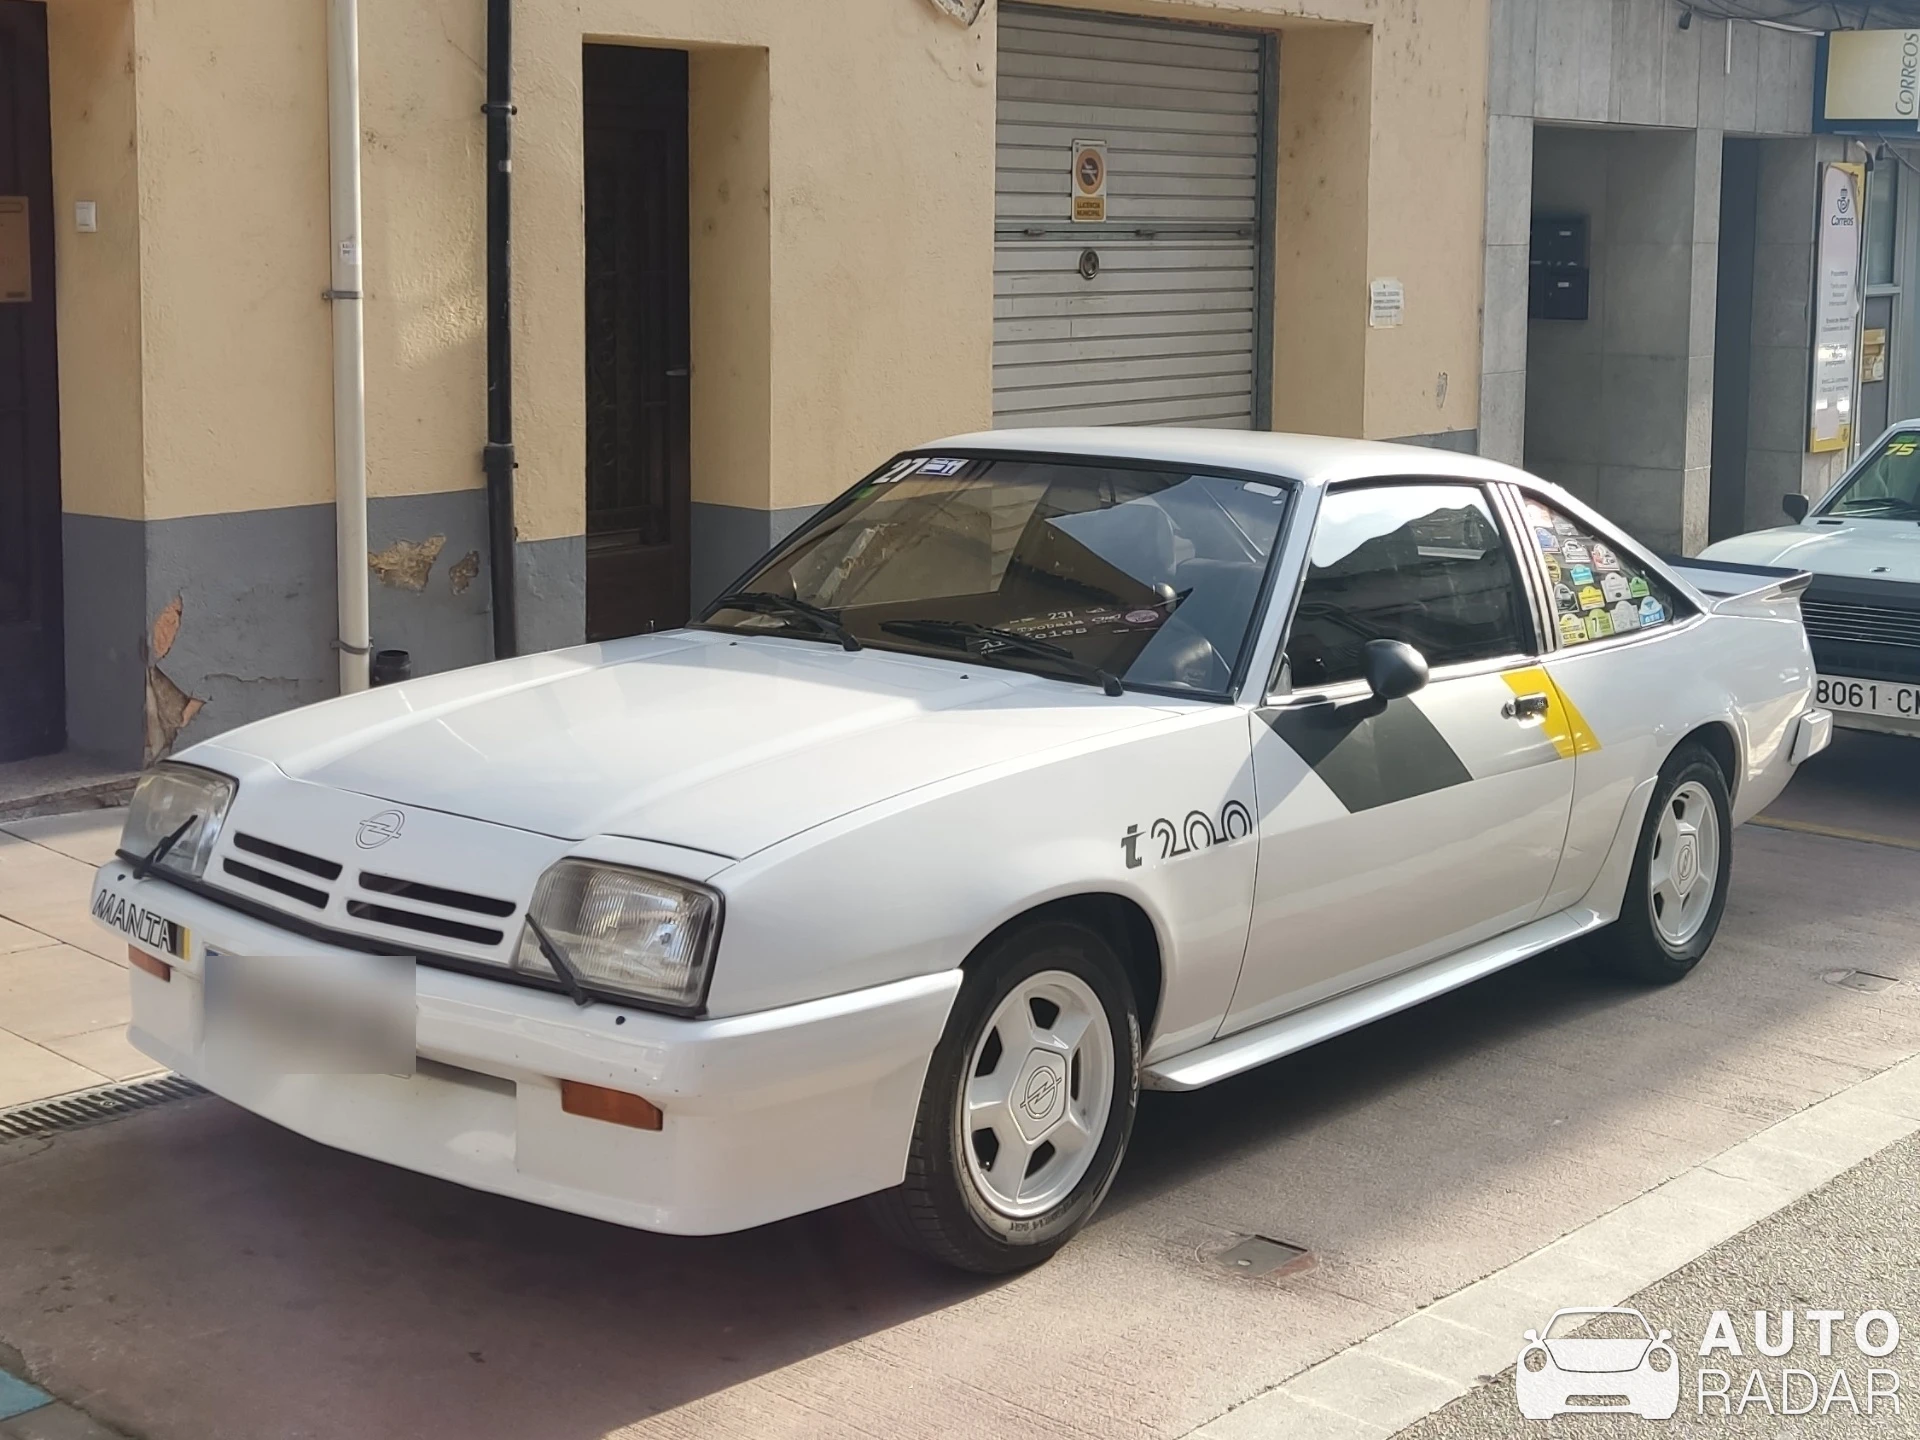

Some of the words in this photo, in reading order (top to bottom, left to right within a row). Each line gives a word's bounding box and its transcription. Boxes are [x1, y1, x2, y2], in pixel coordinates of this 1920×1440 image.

[1895, 32, 1919, 116] CORREOS
[1831, 215, 1854, 226] Correos
[1884, 443, 1918, 456] 75
[1047, 611, 1075, 621] 231
[91, 888, 174, 955] MANTA
